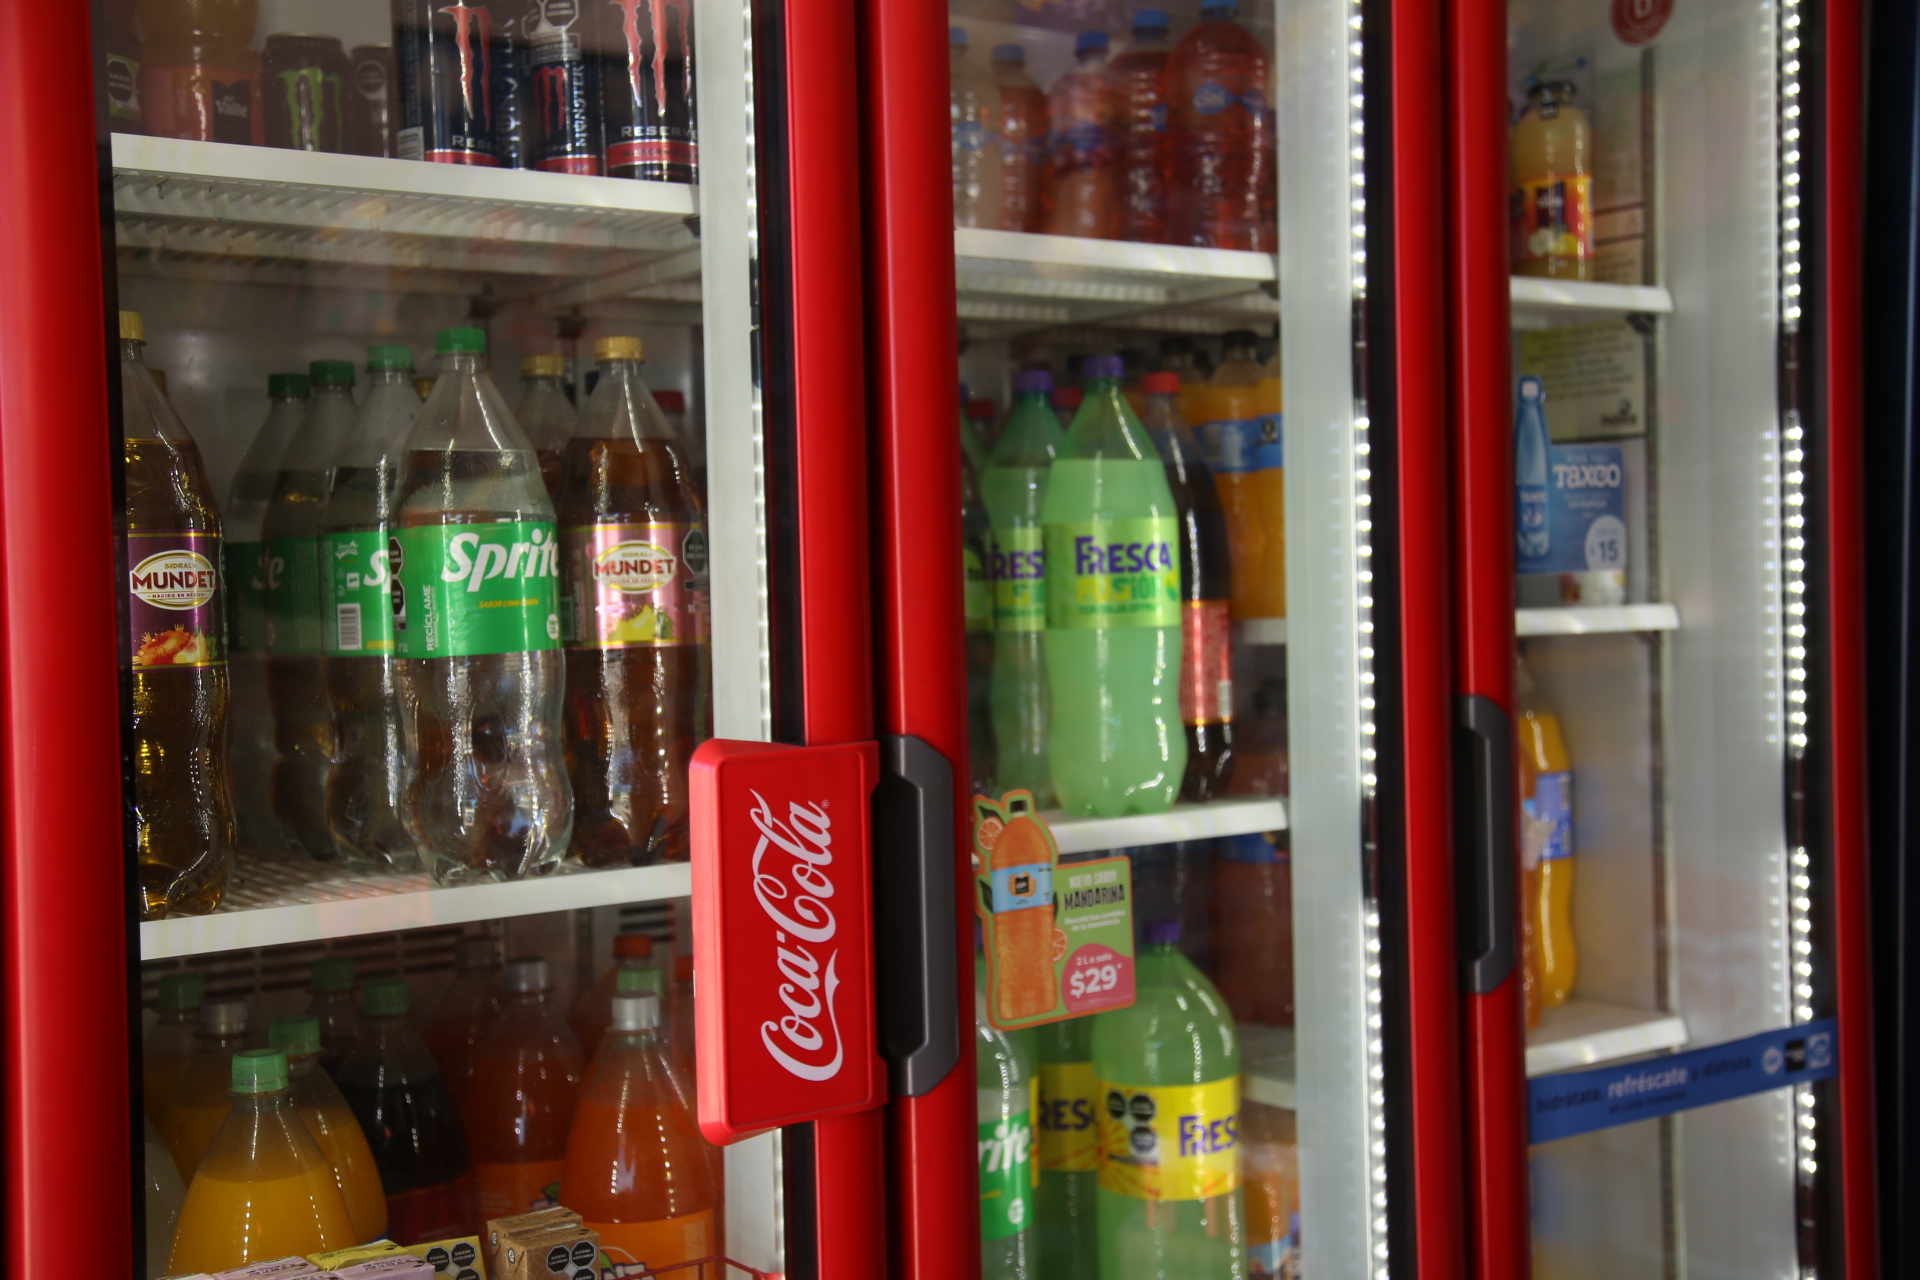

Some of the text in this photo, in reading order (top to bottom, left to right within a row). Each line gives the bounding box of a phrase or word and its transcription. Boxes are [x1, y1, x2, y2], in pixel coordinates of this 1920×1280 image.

[215, 100, 249, 118] Valle
[1075, 536, 1173, 576] FRESCA
[1600, 539, 1619, 563] 15
[164, 562, 193, 570] SIDRAL
[594, 559, 675, 577] MUNDET
[132, 570, 215, 590] MUNDET
[1064, 884, 1125, 911] MANDARINA
[749, 788, 843, 1082] Coca-Cola
[1607, 1066, 1689, 1099] refréscate
